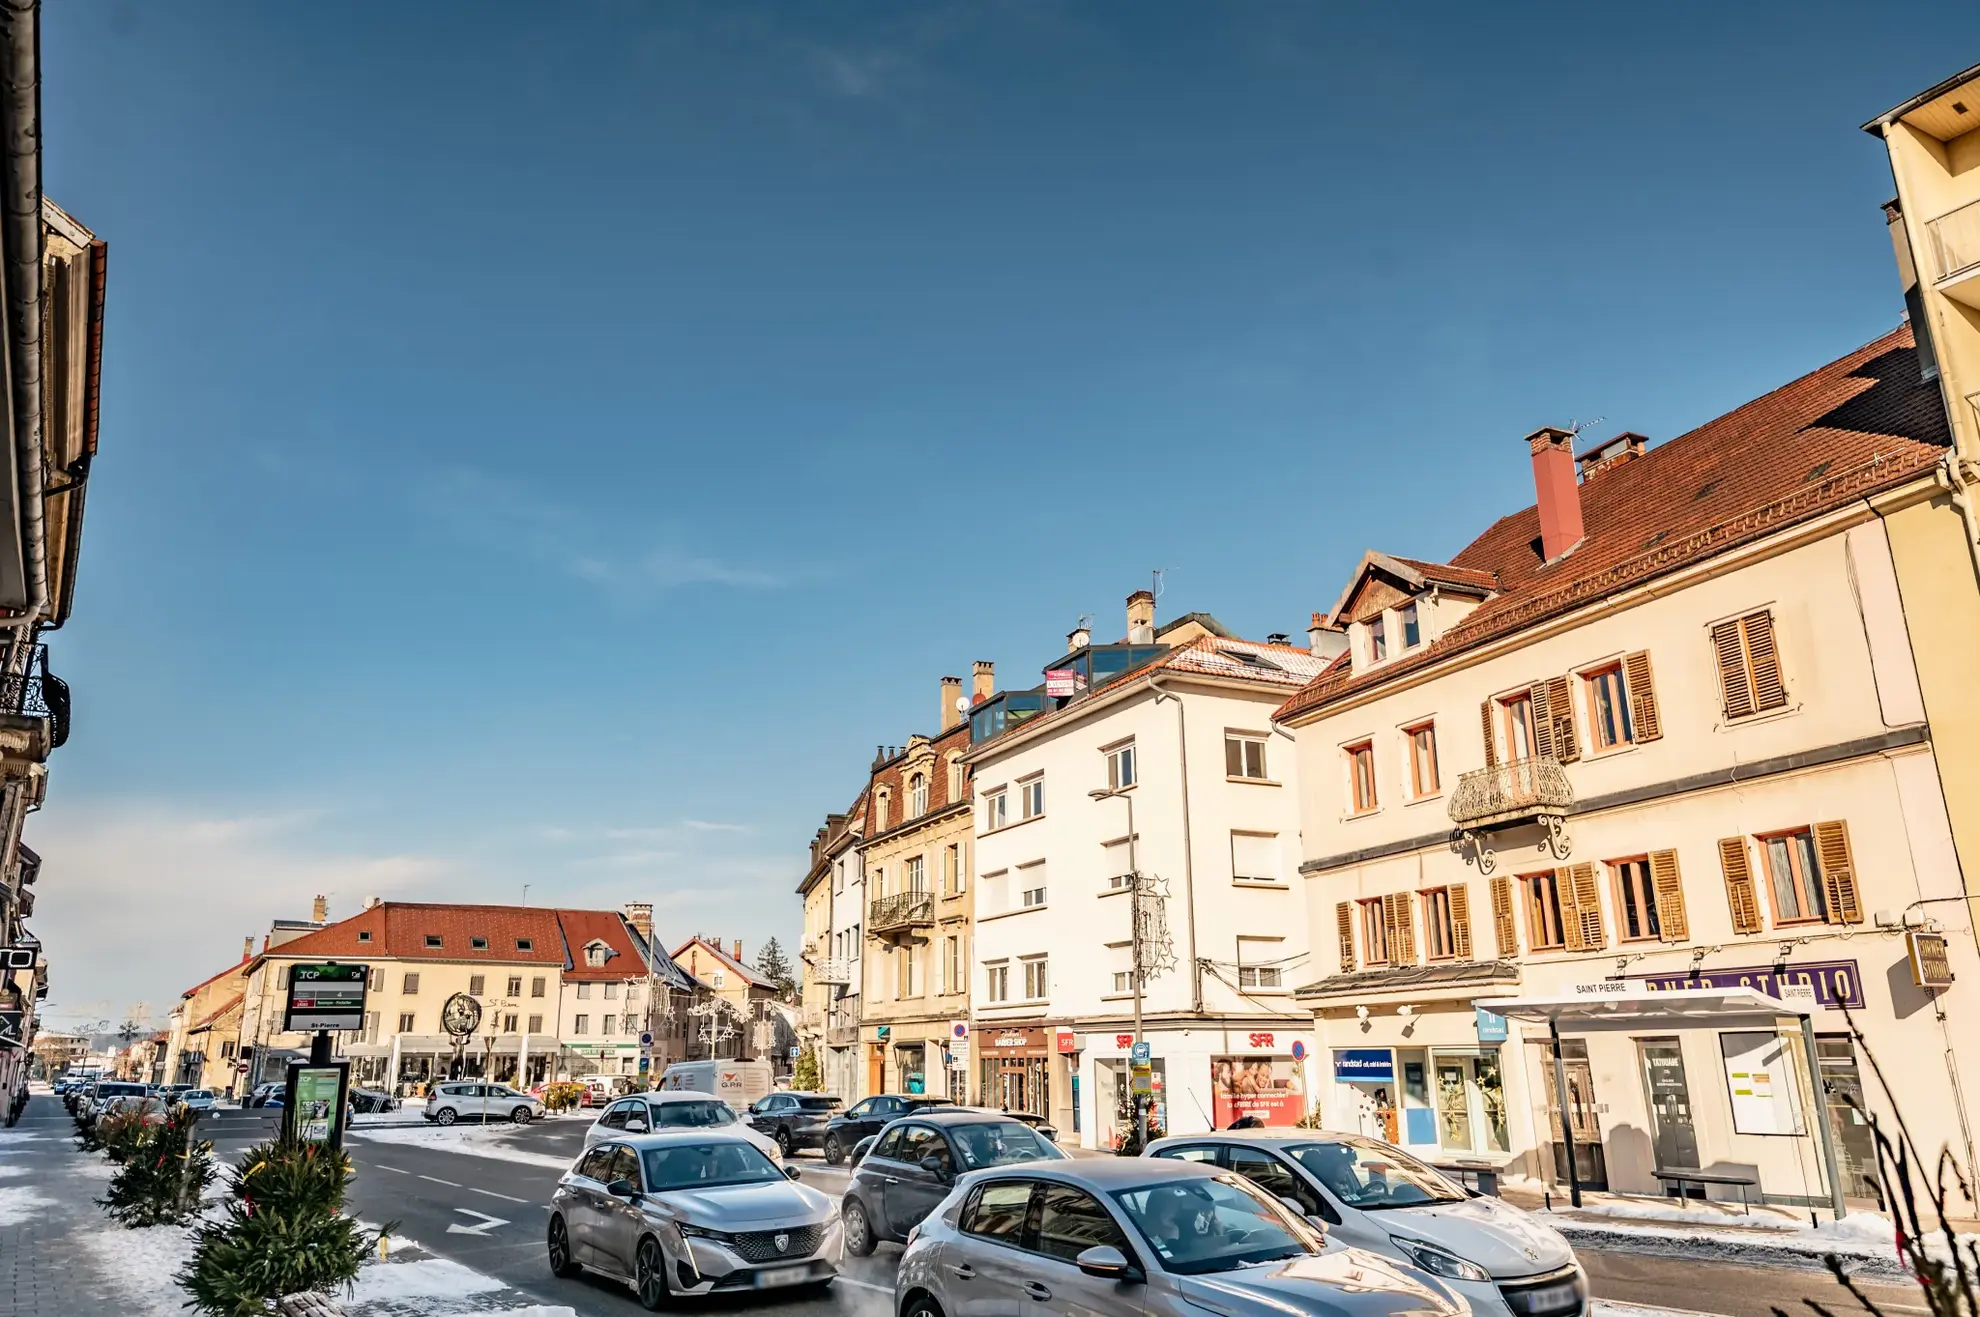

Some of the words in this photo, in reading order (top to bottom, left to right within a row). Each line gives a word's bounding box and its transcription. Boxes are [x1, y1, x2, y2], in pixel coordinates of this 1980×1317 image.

[1918, 940, 1945, 957] CORNER
[301, 971, 320, 979] TCP
[1923, 961, 1950, 978] STUDIO
[1576, 984, 1597, 994] SAINT
[1598, 982, 1626, 993] PIERRE
[1116, 1034, 1134, 1048] SFR
[1249, 1032, 1274, 1048] SFR
